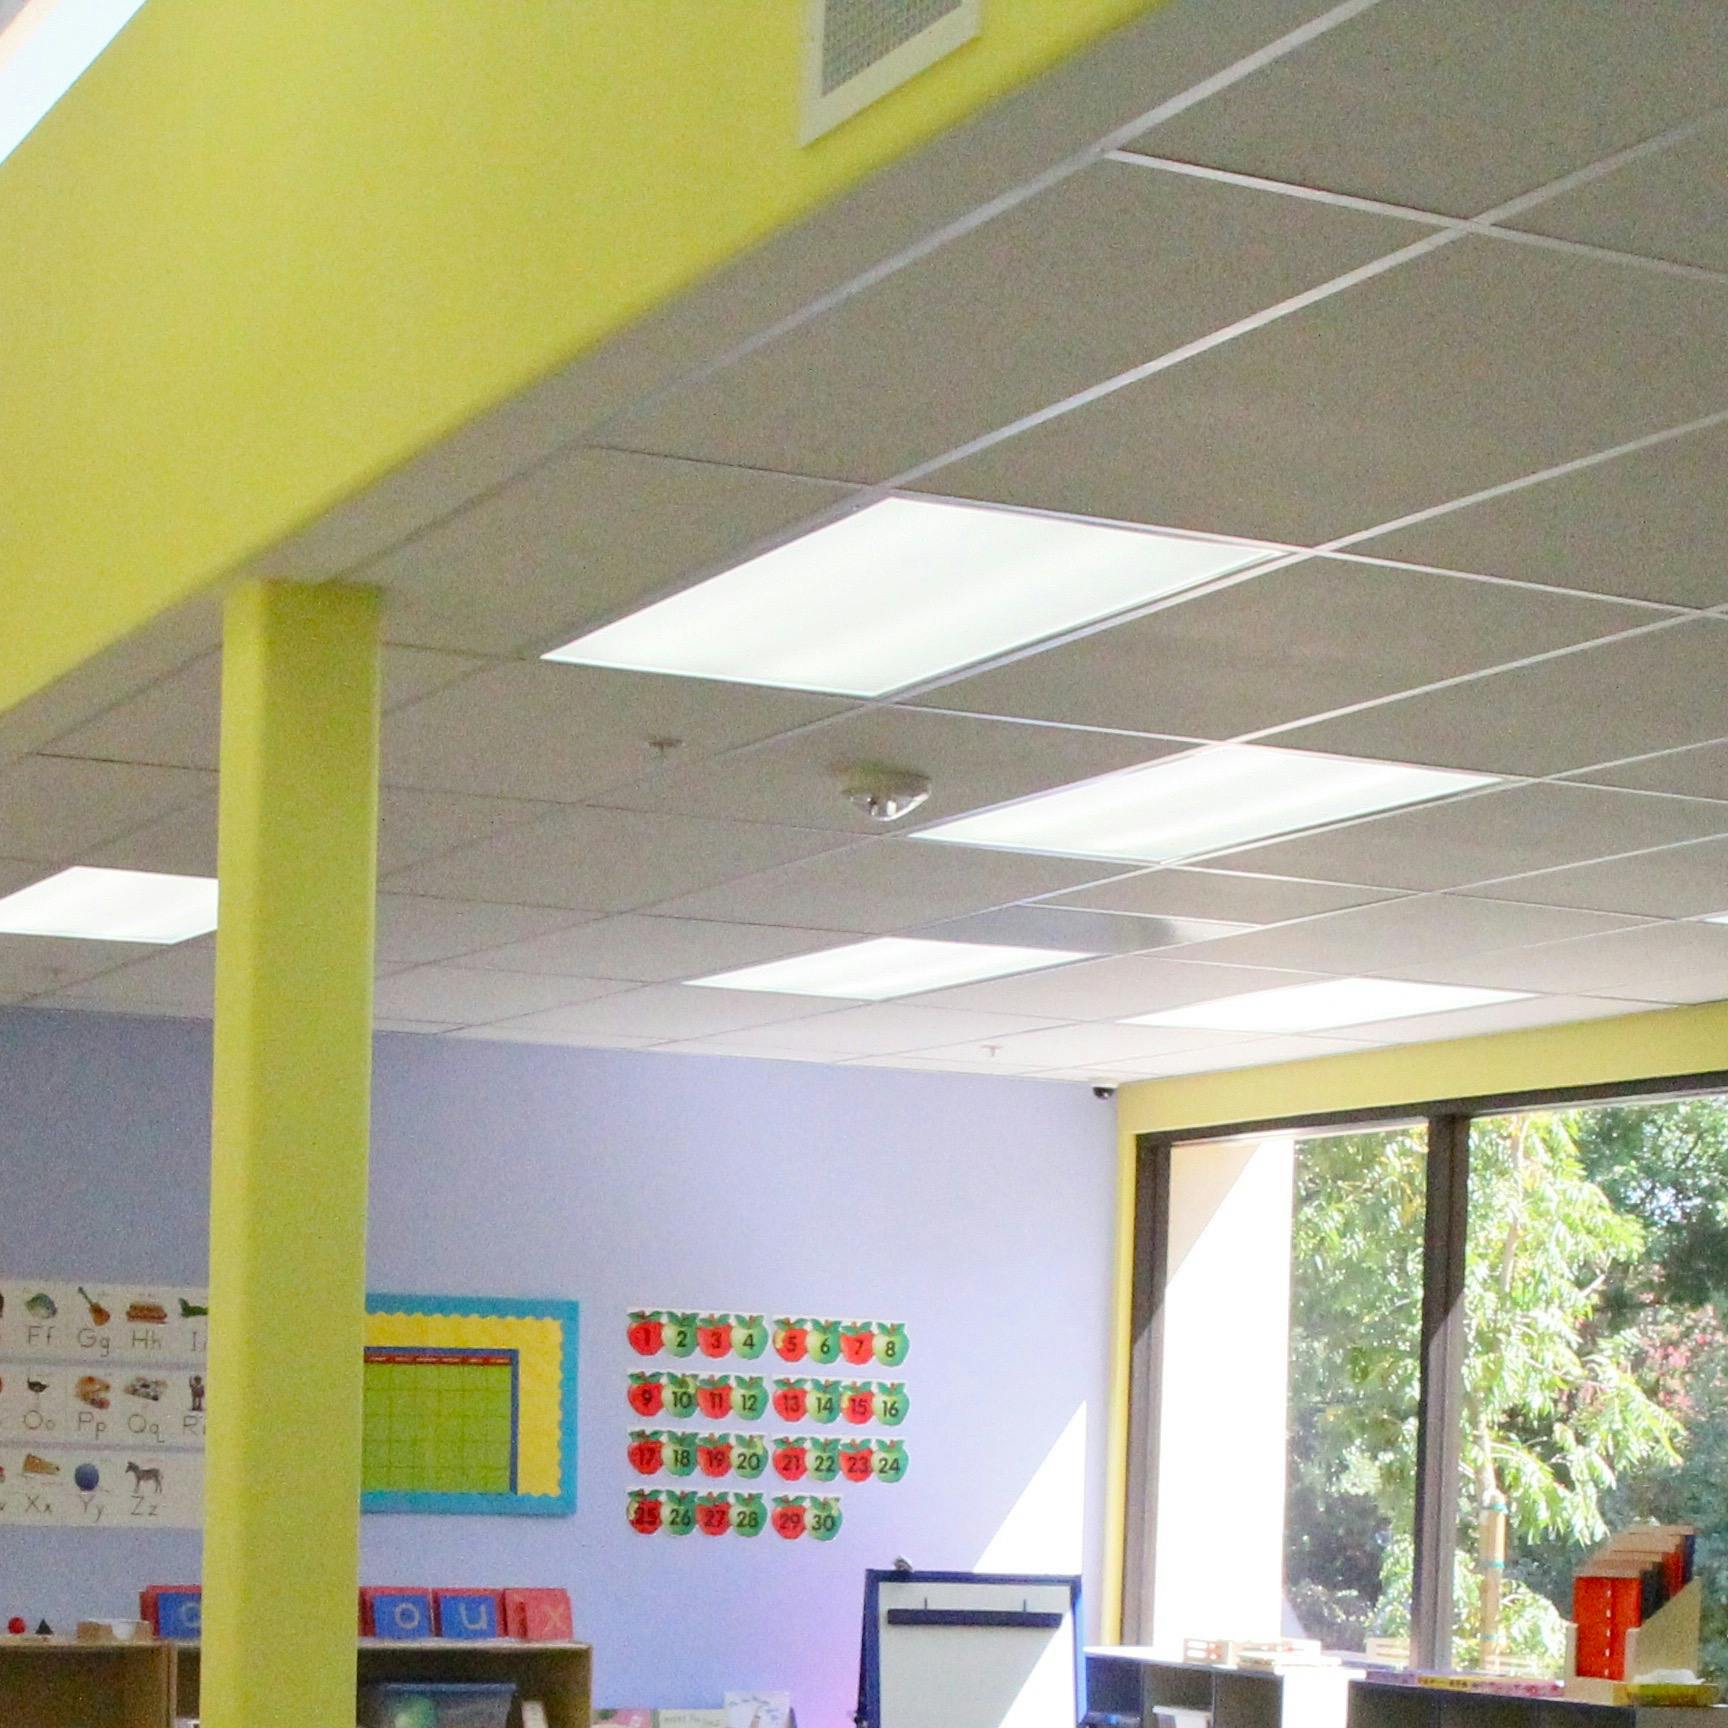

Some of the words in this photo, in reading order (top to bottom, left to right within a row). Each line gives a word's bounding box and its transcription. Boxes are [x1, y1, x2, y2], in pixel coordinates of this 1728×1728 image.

[25, 1325, 56, 1344] Ff
[77, 1328, 111, 1356] Gg
[130, 1329, 162, 1350] Hh
[642, 1330, 651, 1347] 1
[675, 1331, 688, 1348] 2
[709, 1331, 722, 1348] 3
[742, 1332, 755, 1350] 4
[786, 1335, 797, 1352] 5
[820, 1337, 831, 1354] 6
[854, 1338, 864, 1355] 7
[885, 1340, 896, 1357] 8
[640, 1389, 652, 1406] 9
[671, 1390, 691, 1408] 10
[709, 1392, 723, 1409] 11
[740, 1393, 758, 1411] 12
[782, 1395, 800, 1413] 13
[815, 1397, 834, 1414] 14
[849, 1399, 868, 1416] 15
[881, 1401, 899, 1418] 16
[77, 1413, 108, 1439] Pp
[127, 1415, 165, 1442] Qq
[639, 1450, 657, 1467] 17
[672, 1451, 691, 1468] 18
[707, 1451, 726, 1469] 19
[737, 1452, 760, 1470] 20
[782, 1453, 801, 1471] 21
[814, 1454, 835, 1471] 22
[848, 1455, 870, 1472] 23
[878, 1456, 900, 1474] 24
[78, 1496, 104, 1522] Yy
[130, 1496, 158, 1517] Zz
[635, 1509, 657, 1526] 25
[669, 1509, 692, 1526] 26
[704, 1510, 726, 1527] 27
[736, 1510, 759, 1527] 28
[779, 1513, 801, 1531] 29
[812, 1515, 835, 1532] 30
[460, 1603, 488, 1630] u
